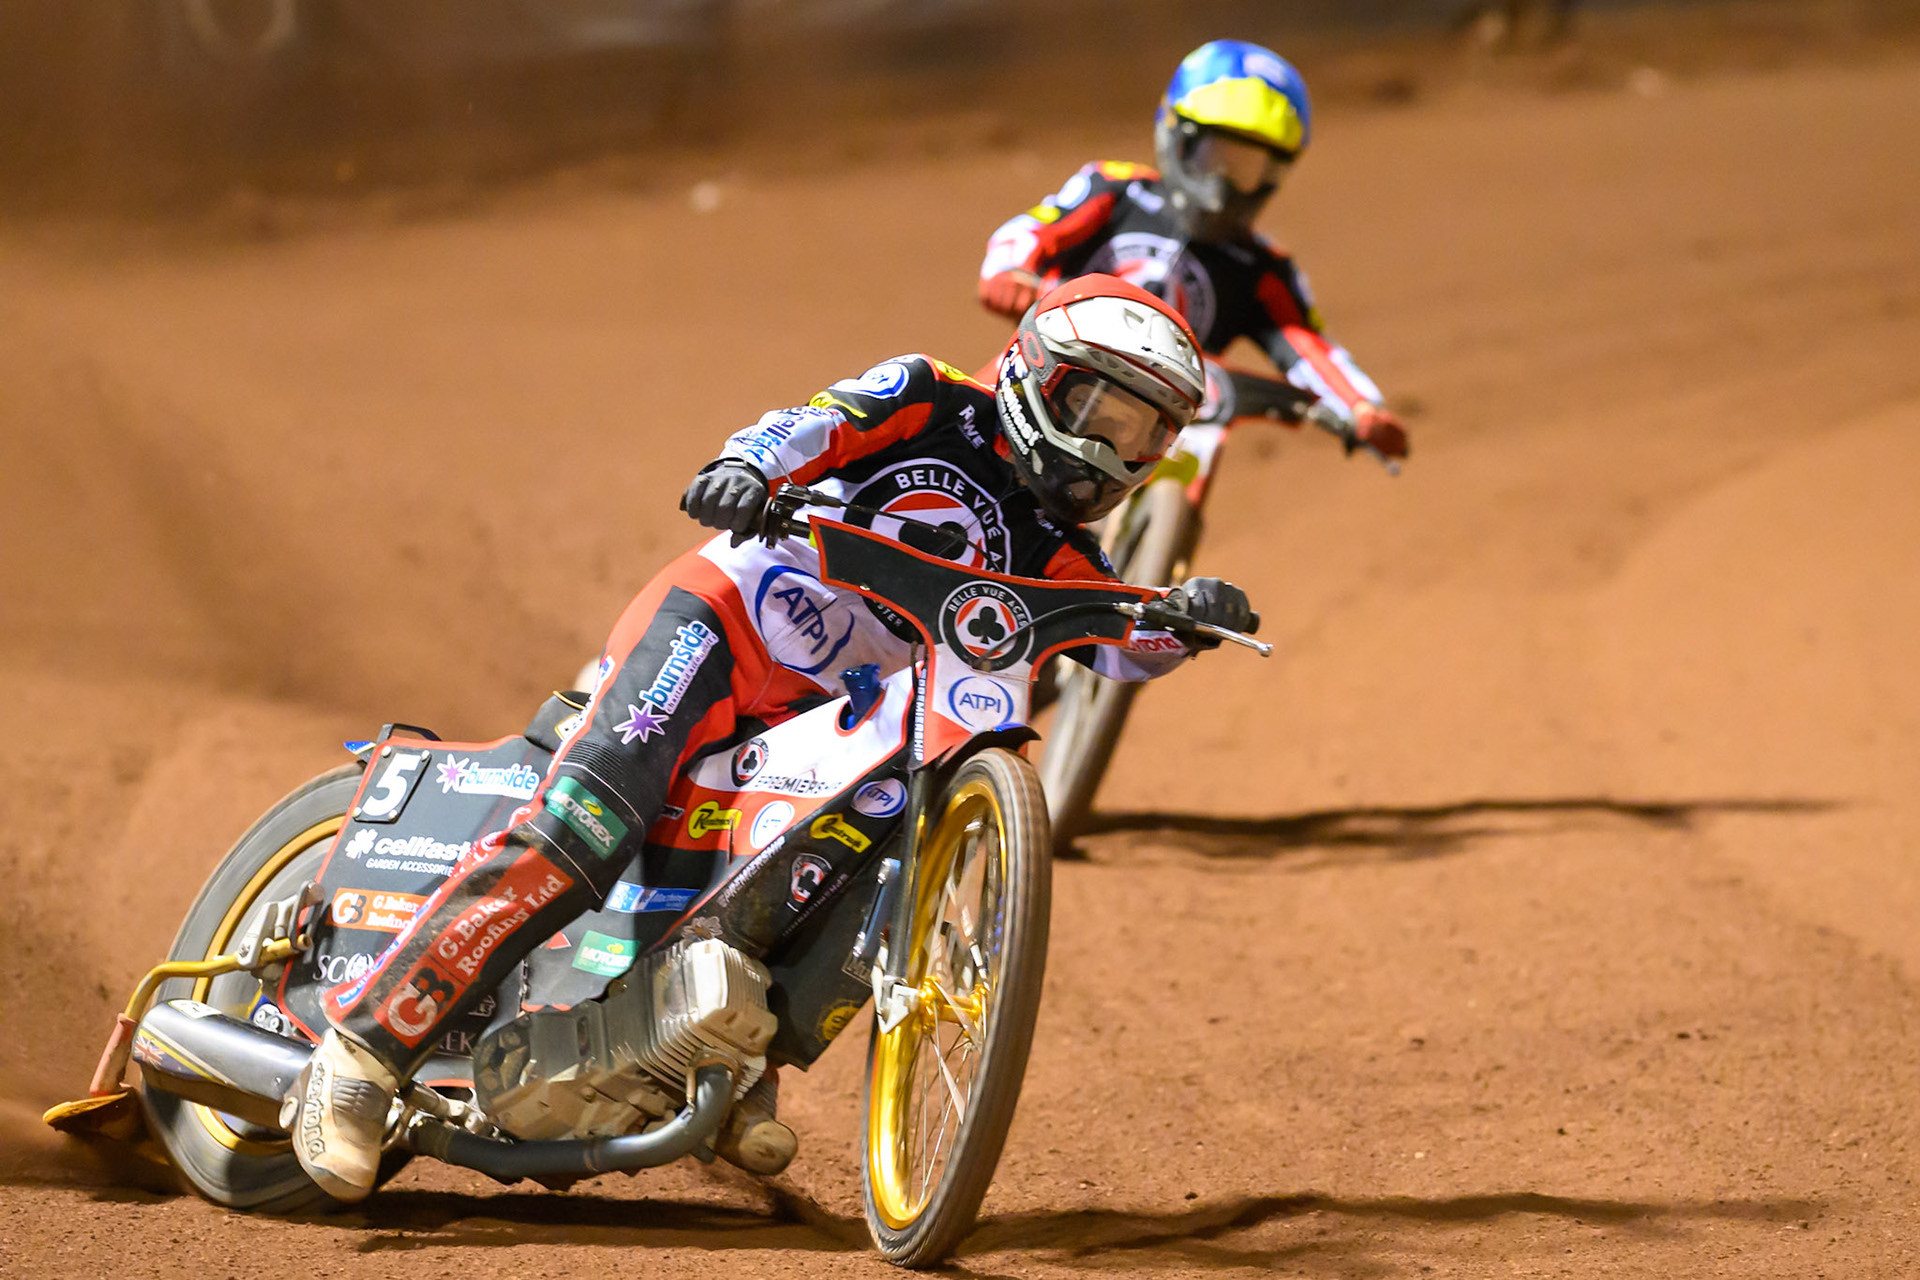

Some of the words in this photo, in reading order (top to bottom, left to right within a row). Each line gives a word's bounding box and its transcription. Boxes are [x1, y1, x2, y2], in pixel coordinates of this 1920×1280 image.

[895, 470, 966, 498] BELLE
[973, 494, 1001, 540] VUE
[773, 587, 829, 656] ATPI
[948, 586, 978, 613] BELLE
[982, 586, 1006, 600] VUE
[642, 622, 709, 707] burnside
[959, 692, 1002, 713] ATPI
[362, 753, 421, 816] 5
[465, 765, 537, 790] burnside
[550, 790, 615, 848] MOTOREX
[366, 858, 400, 870] GARDEN
[400, 861, 455, 877] ACCESSORIE
[374, 836, 471, 861] cellfast
[455, 908, 531, 977] Roofing
[524, 874, 564, 909] Ltd
